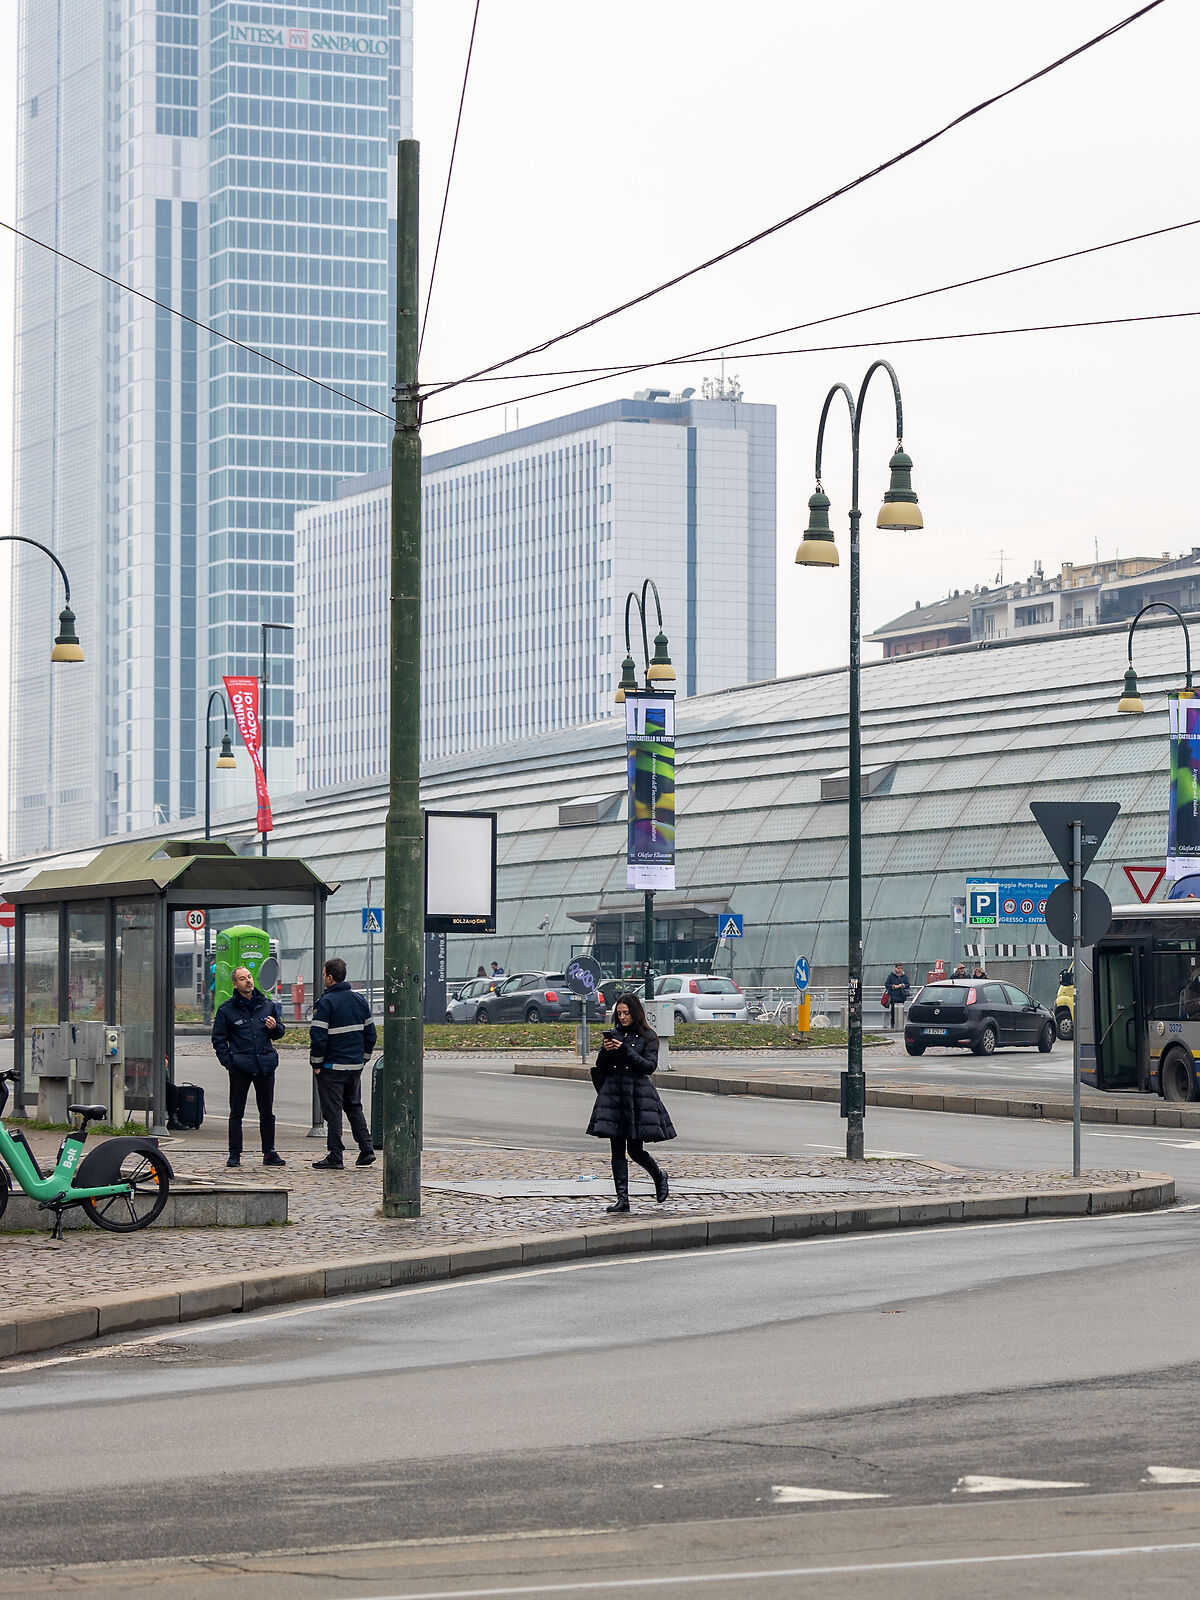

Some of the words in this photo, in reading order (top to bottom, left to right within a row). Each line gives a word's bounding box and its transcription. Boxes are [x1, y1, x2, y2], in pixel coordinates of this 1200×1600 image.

[229, 24, 283, 45] INTESA
[311, 33, 389, 56] SANPAOLO
[976, 895, 991, 914] P
[1023, 903, 1031, 911] 10
[190, 913, 203, 925] 30
[972, 917, 995, 925] LIBERO
[1168, 1023, 1183, 1033] 3372
[62, 1147, 78, 1169] Bolt
